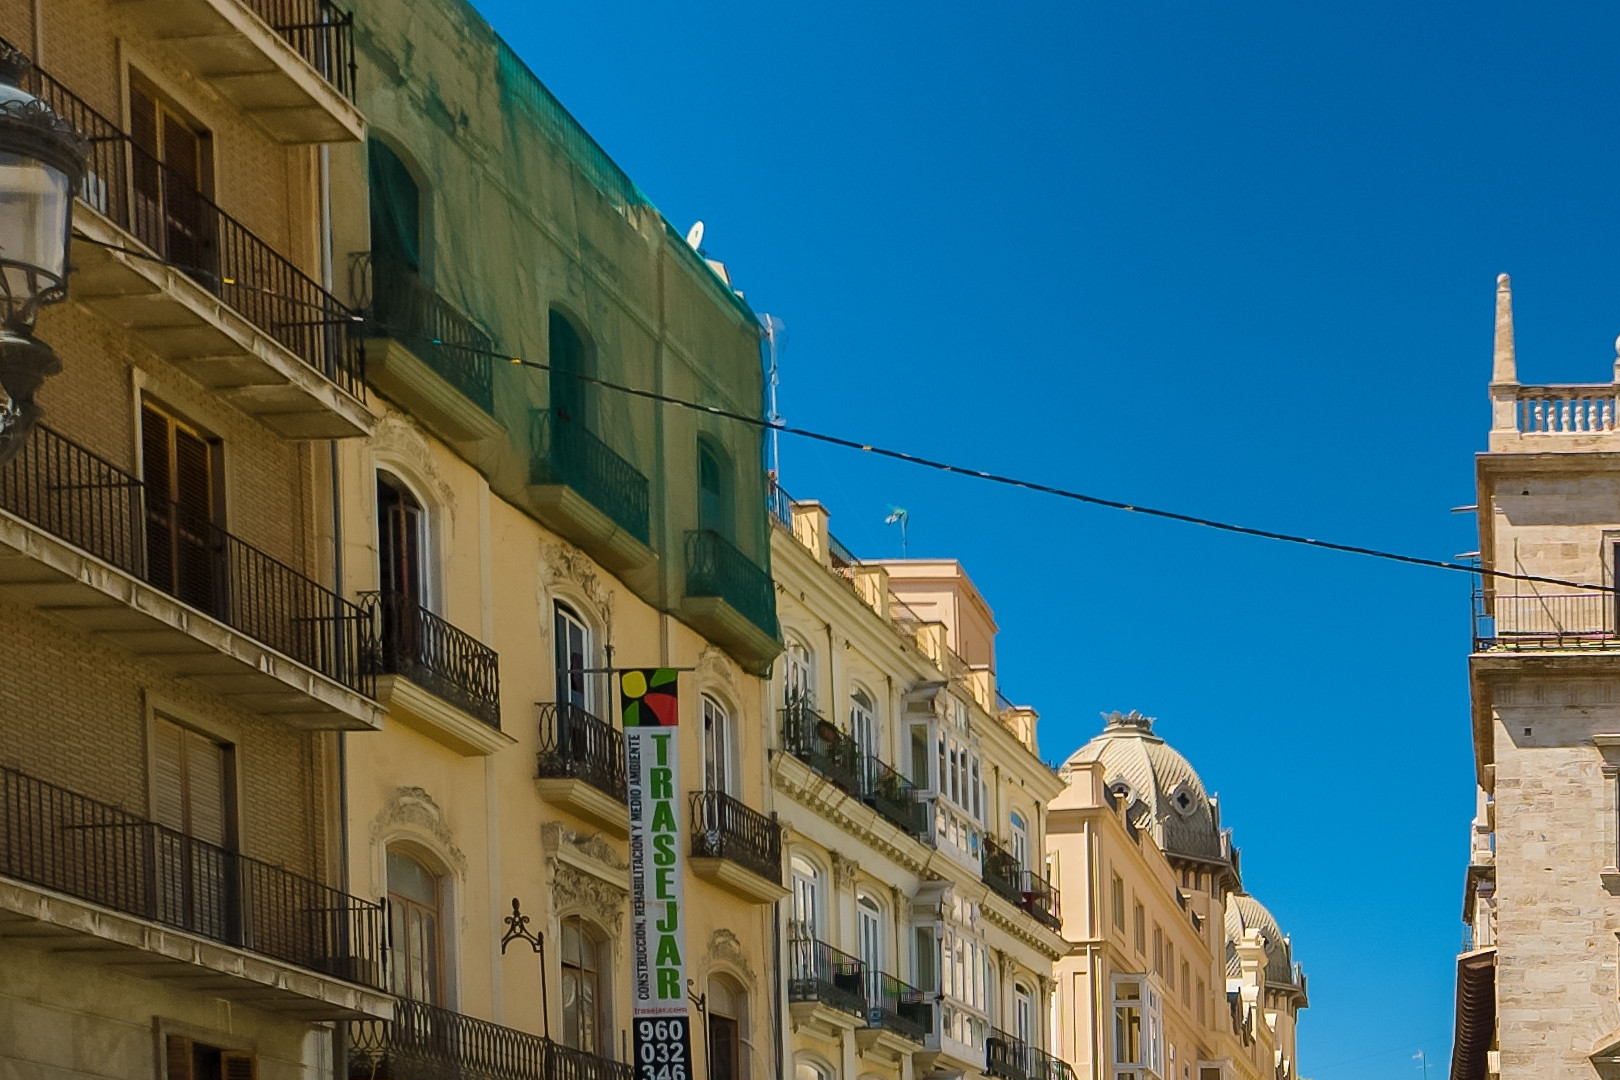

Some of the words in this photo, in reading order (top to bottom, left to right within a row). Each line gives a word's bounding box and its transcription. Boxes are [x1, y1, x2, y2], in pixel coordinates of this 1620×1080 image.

[628, 734, 641, 786] AMBIENTE
[630, 788, 643, 822] MEDIO
[650, 733, 682, 1000] TRASEJAR
[634, 1007, 688, 1016] trasejar.com
[639, 1020, 683, 1042] 960
[641, 1042, 685, 1063] 032
